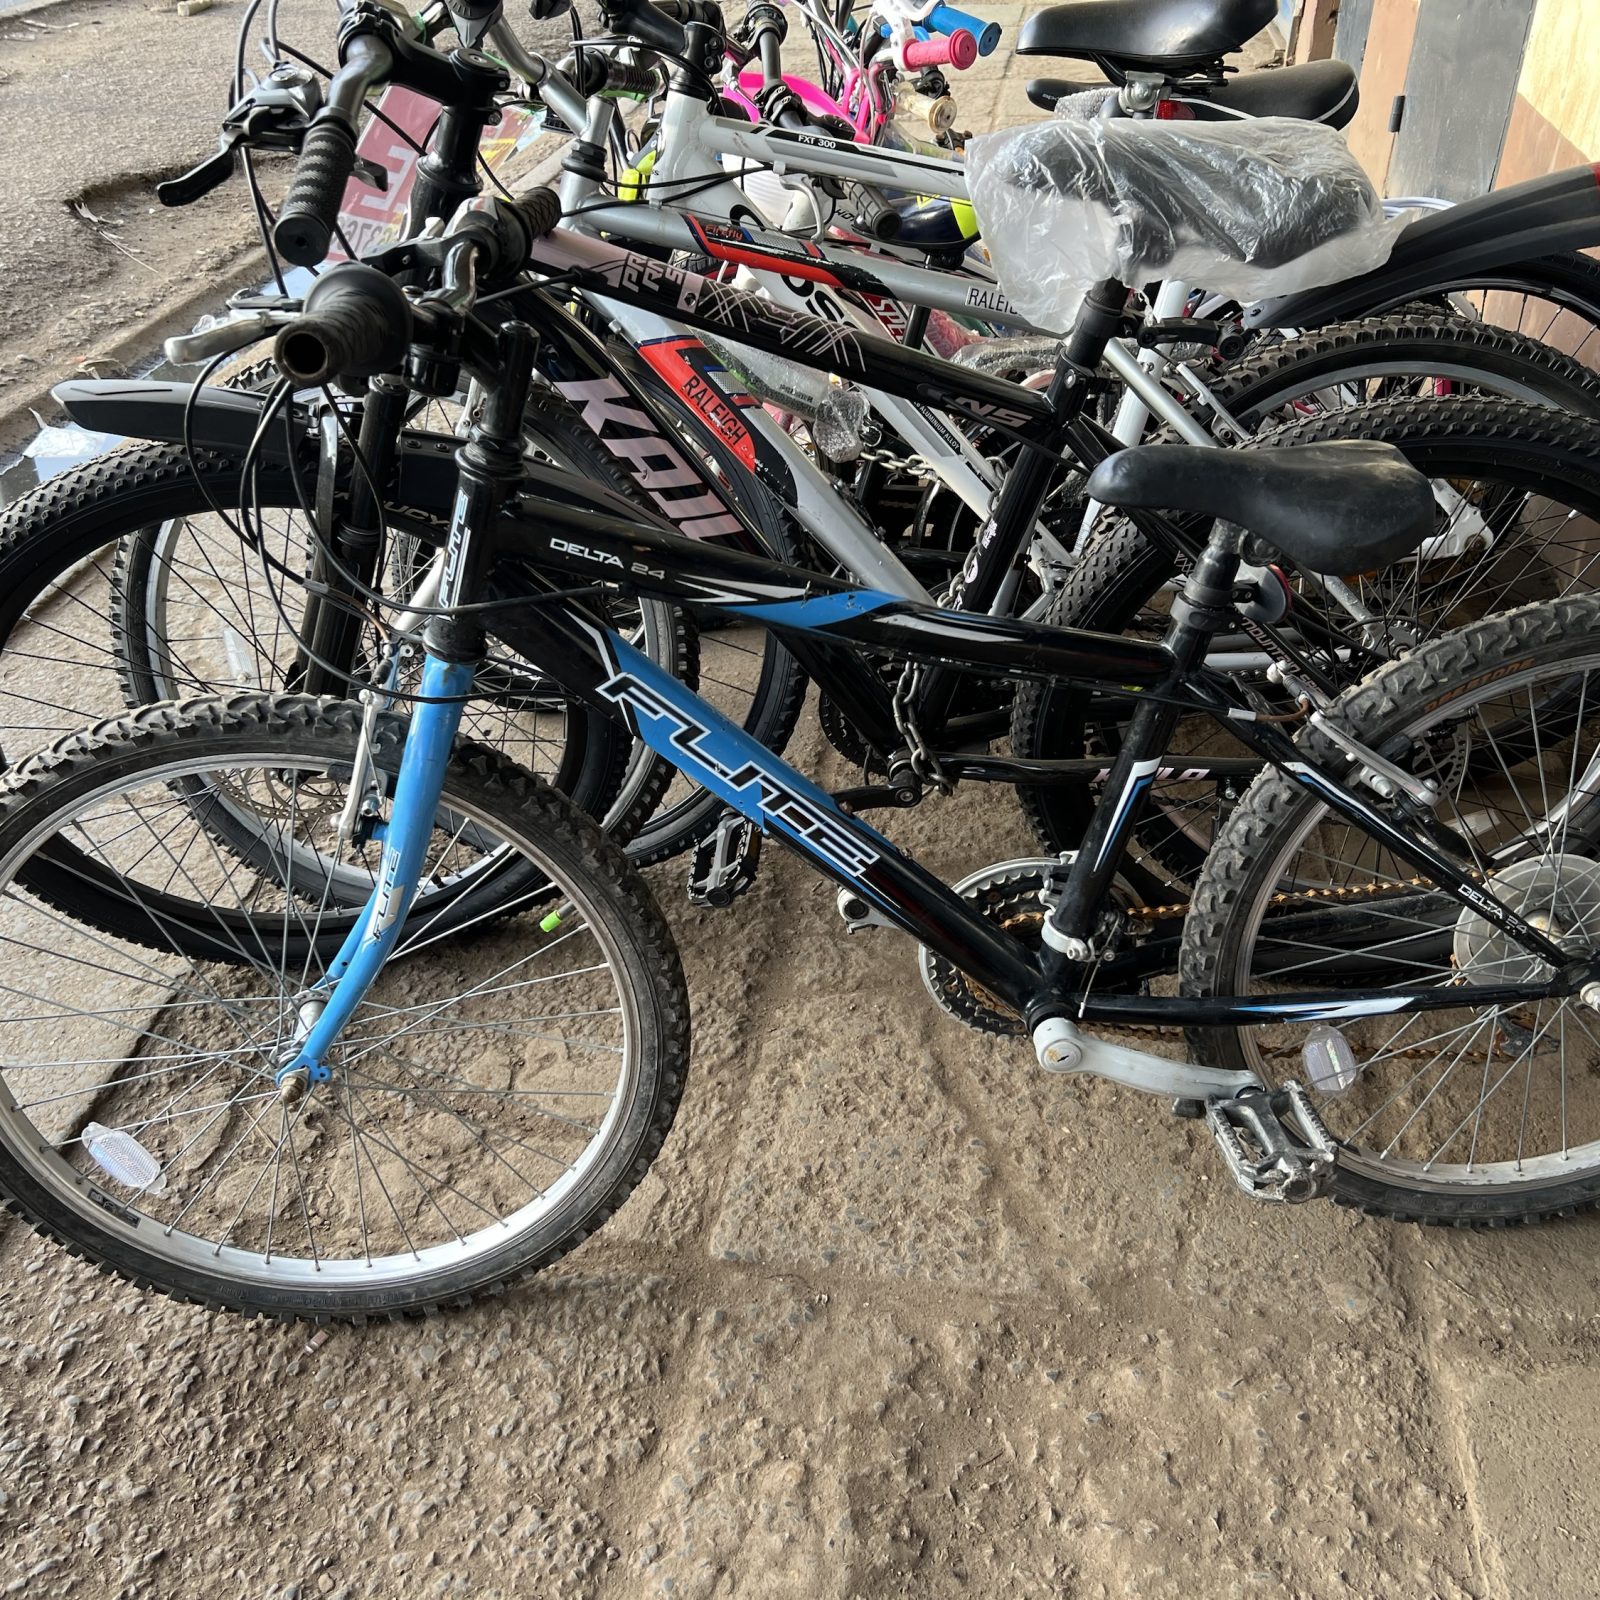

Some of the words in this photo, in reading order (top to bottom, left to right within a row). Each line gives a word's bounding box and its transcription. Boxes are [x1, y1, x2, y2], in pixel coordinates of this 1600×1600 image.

[798, 135, 815, 145] FXT
[818, 138, 837, 149] 300
[683, 376, 747, 446] RALEIGH
[919, 405, 947, 434] ALUMINIUM
[944, 432, 960, 450] ALLOY
[550, 538, 624, 569] DELTA
[631, 562, 665, 580] 24
[595, 672, 880, 877] FLITE
[1458, 884, 1503, 919] DELTA
[1505, 915, 1528, 934] 24
